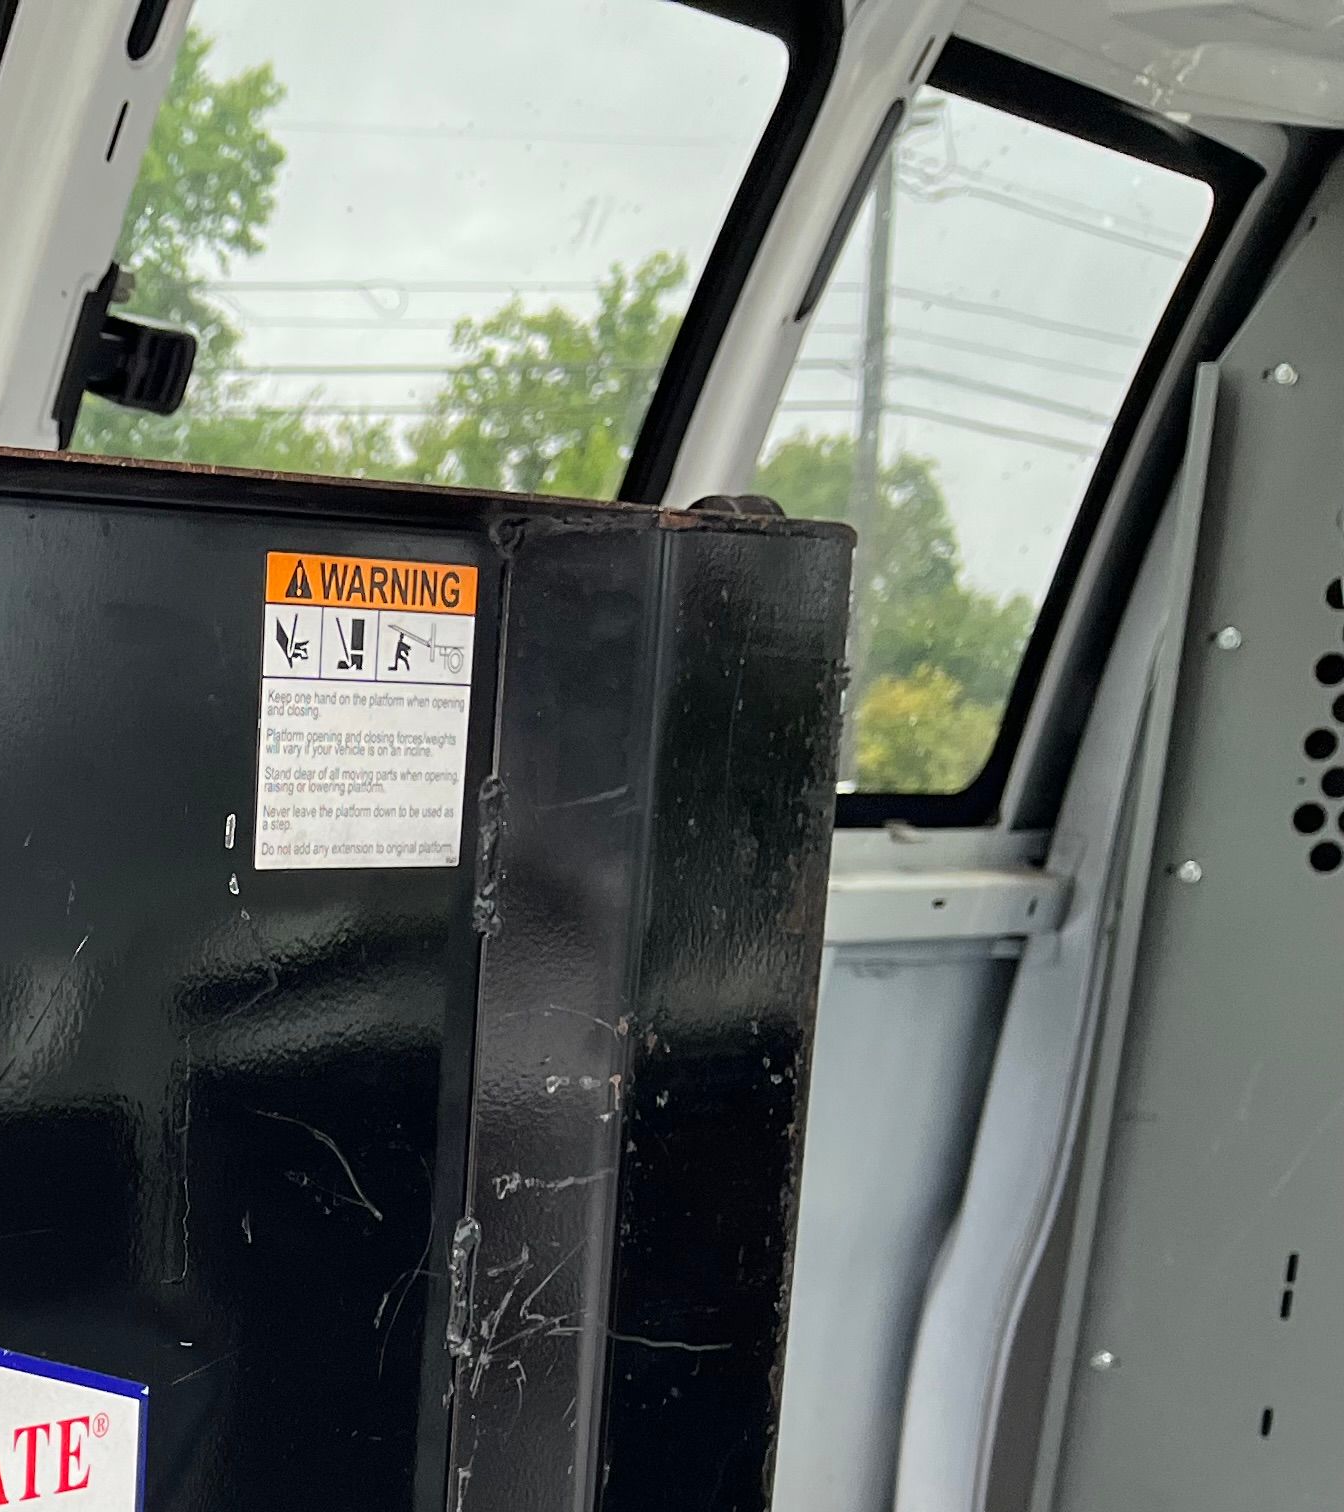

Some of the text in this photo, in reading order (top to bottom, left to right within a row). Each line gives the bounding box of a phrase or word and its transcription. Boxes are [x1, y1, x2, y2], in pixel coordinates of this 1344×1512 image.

[321, 562, 460, 608] WARNING
[267, 689, 464, 712] Keep one hand on the platform when opening
[267, 704, 284, 716] and
[266, 728, 304, 742] Platform
[306, 731, 342, 746] opening
[345, 731, 361, 743] and
[364, 731, 394, 747] closing
[283, 744, 301, 758] vary
[313, 744, 332, 758] your
[334, 743, 365, 755] vehicle
[265, 766, 291, 780] Stand
[294, 767, 316, 780] clear
[318, 766, 328, 780] of
[342, 768, 373, 784] moving
[376, 769, 398, 782] parts
[400, 769, 422, 781] when
[264, 781, 294, 795] raising
[308, 781, 345, 796] lowering
[263, 804, 290, 817] Never
[293, 804, 316, 817] leave
[319, 804, 333, 817] the
[335, 804, 371, 819] platform
[373, 804, 396, 817] down
[398, 804, 407, 817] to
[409, 804, 419, 817] be
[422, 804, 442, 817] used
[261, 842, 274, 855] Do
[277, 843, 291, 855] not
[294, 842, 310, 855] add
[313, 844, 329, 858] any
[331, 843, 373, 855] extension
